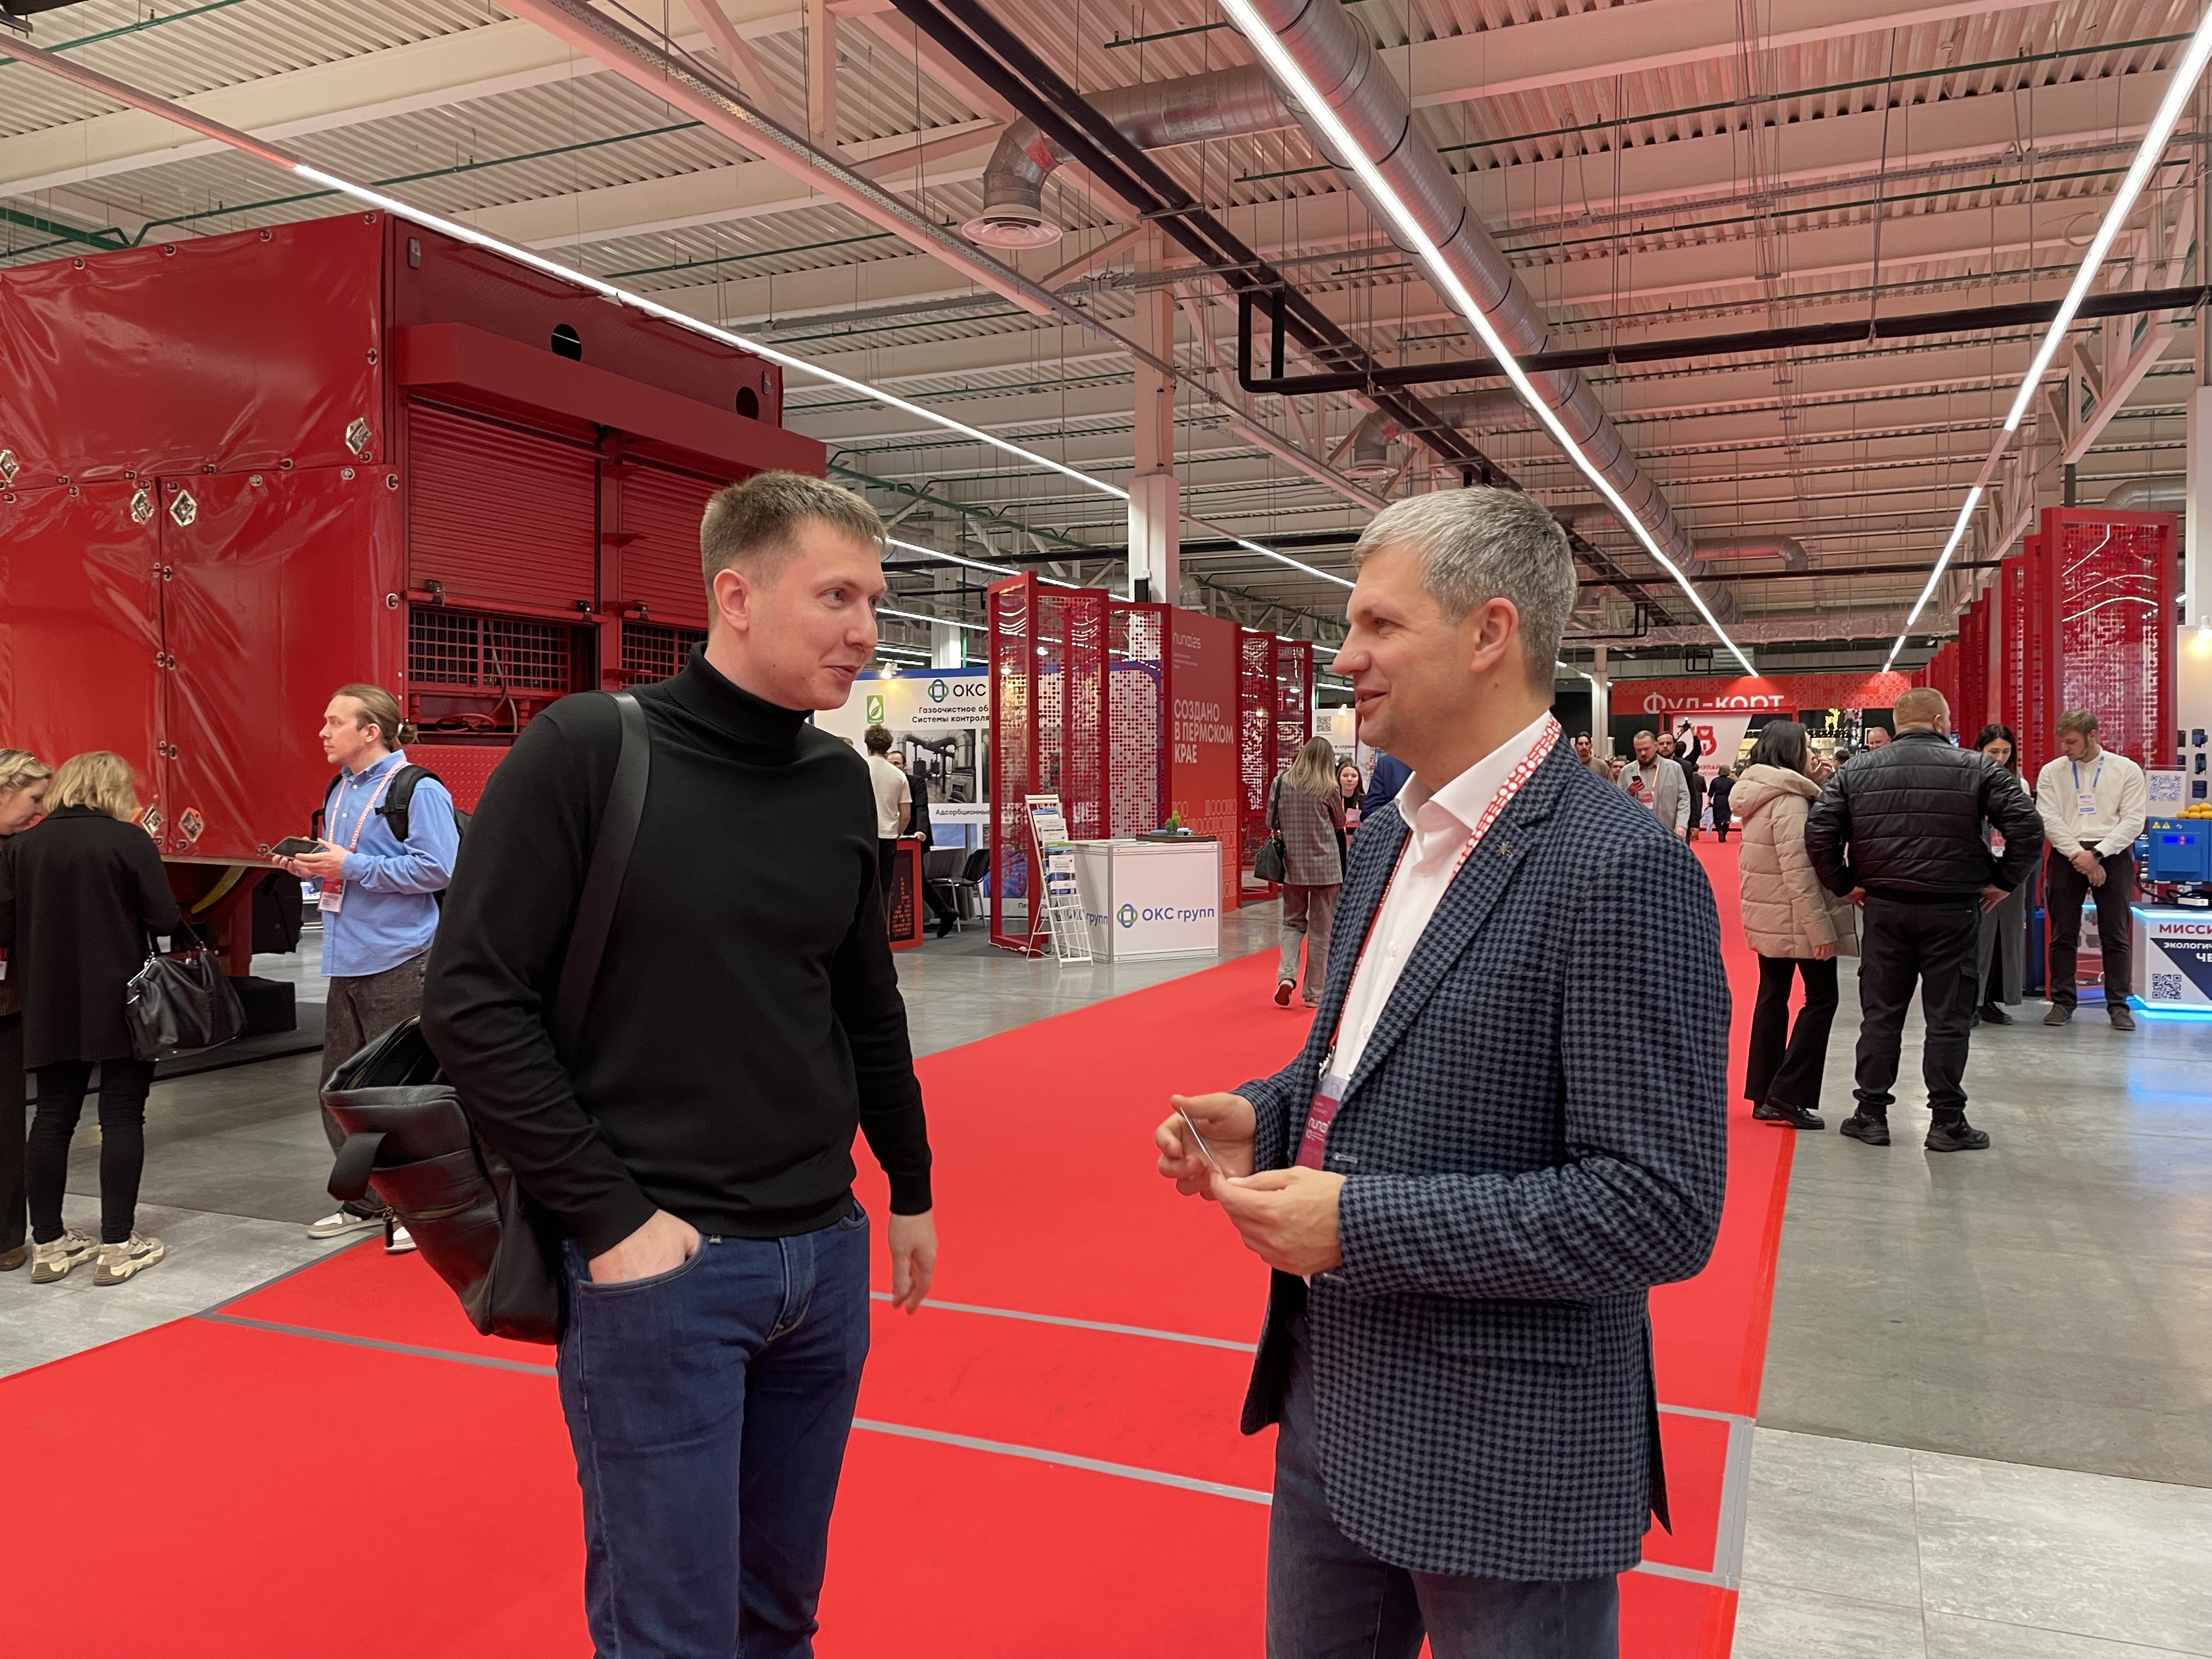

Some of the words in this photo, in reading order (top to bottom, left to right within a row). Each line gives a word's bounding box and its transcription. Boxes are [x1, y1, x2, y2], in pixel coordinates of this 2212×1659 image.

[953, 684, 986, 697] ОКС
[1174, 698, 1220, 723] СОЗДАНО
[951, 715, 989, 724] контроля
[1175, 721, 1180, 741] В
[1182, 722, 1233, 744] ПЕРМСКОМ
[1175, 743, 1197, 763] КРАЕ
[1086, 913, 1108, 926] групп
[1142, 907, 1174, 921] ОКС
[1177, 907, 1214, 922] групп
